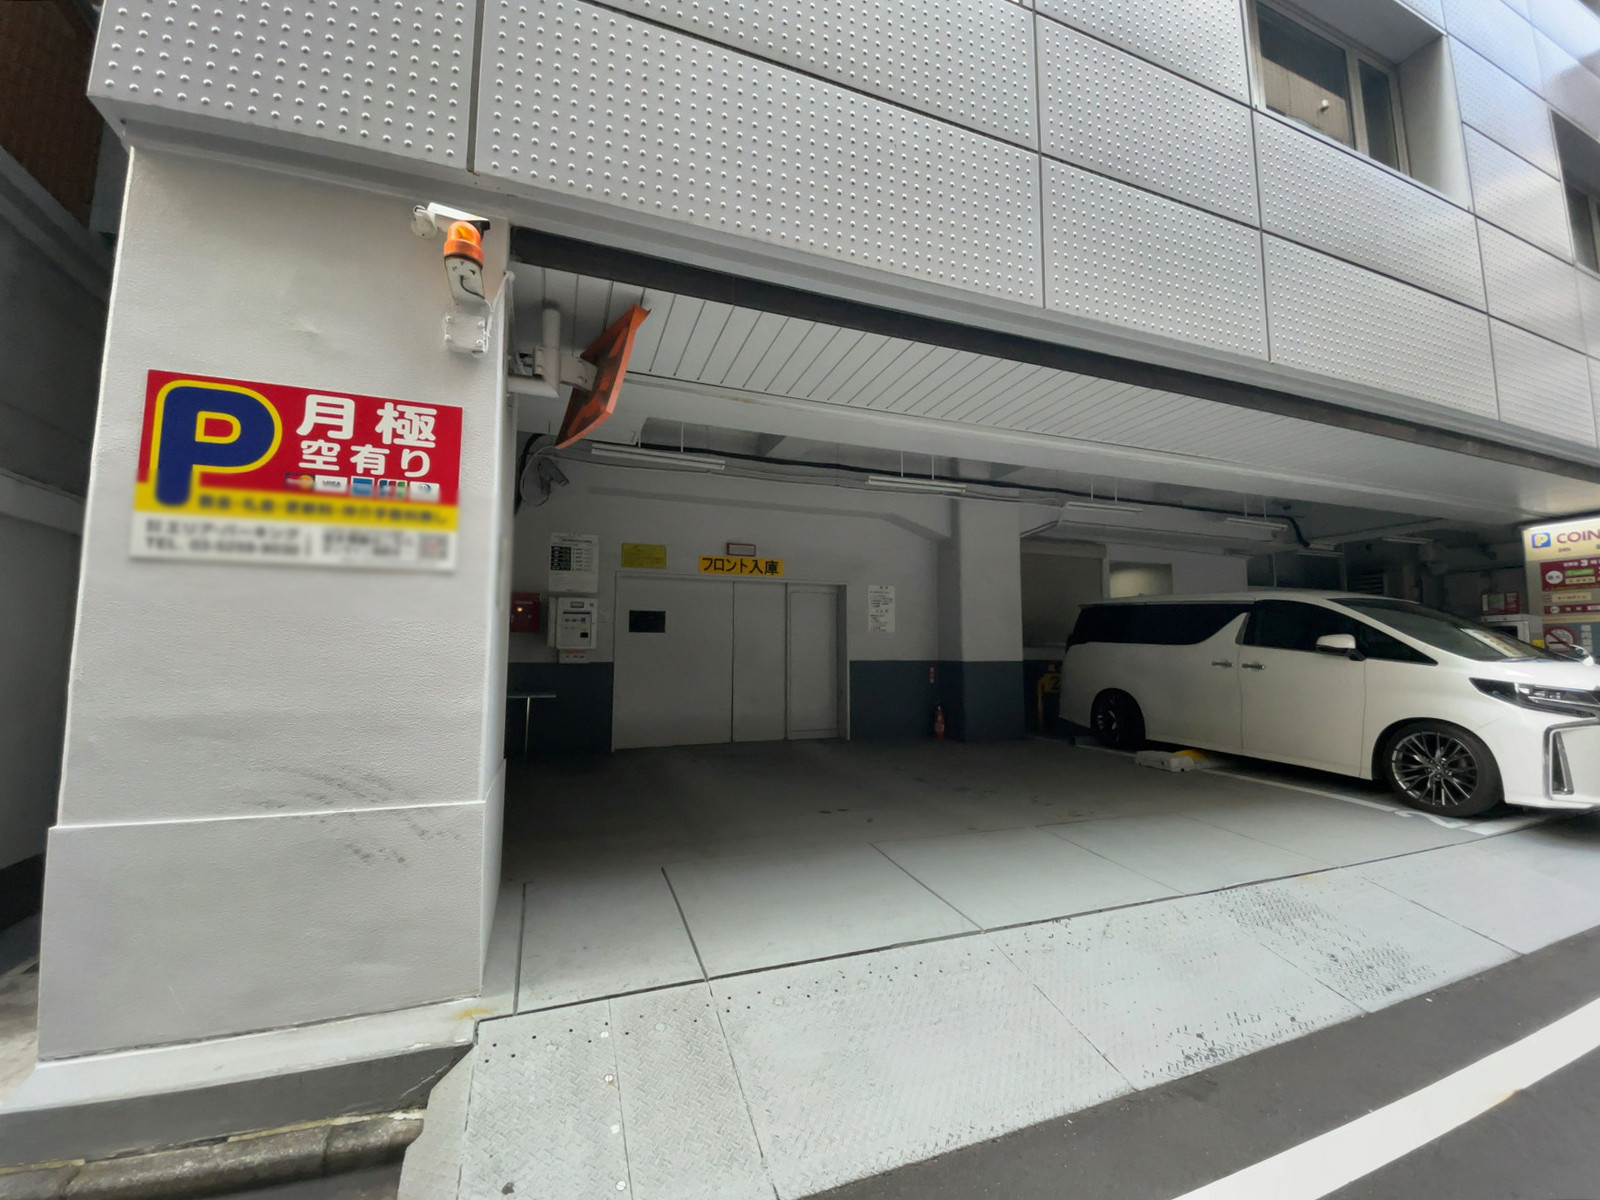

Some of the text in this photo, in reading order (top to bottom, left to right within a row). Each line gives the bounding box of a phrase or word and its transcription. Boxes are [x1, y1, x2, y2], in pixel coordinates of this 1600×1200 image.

[296, 394, 437, 448] 月極
[150, 380, 282, 507] P
[298, 438, 431, 478] 空有り
[1556, 529, 1600, 544] COIN
[702, 557, 780, 576] フロント入庫
